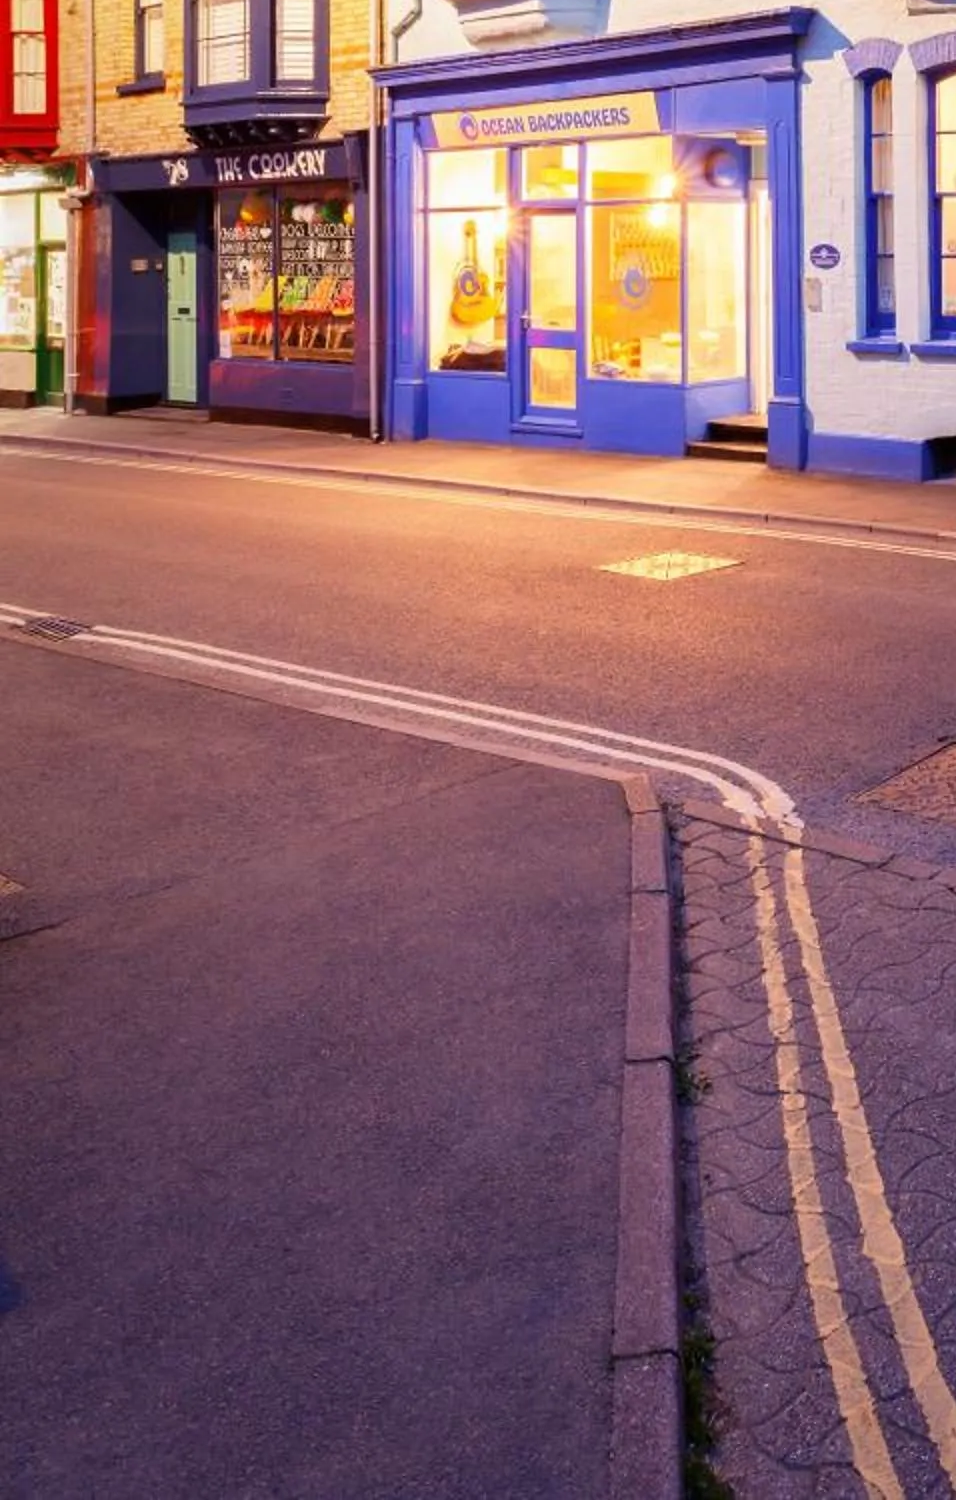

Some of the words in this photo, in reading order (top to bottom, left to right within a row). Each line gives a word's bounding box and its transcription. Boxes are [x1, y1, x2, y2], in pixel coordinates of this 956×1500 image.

[481, 115, 525, 137] OCEAN
[527, 106, 631, 133] BACKPACKERS
[215, 155, 243, 182] THE
[248, 149, 327, 180] COOKERY
